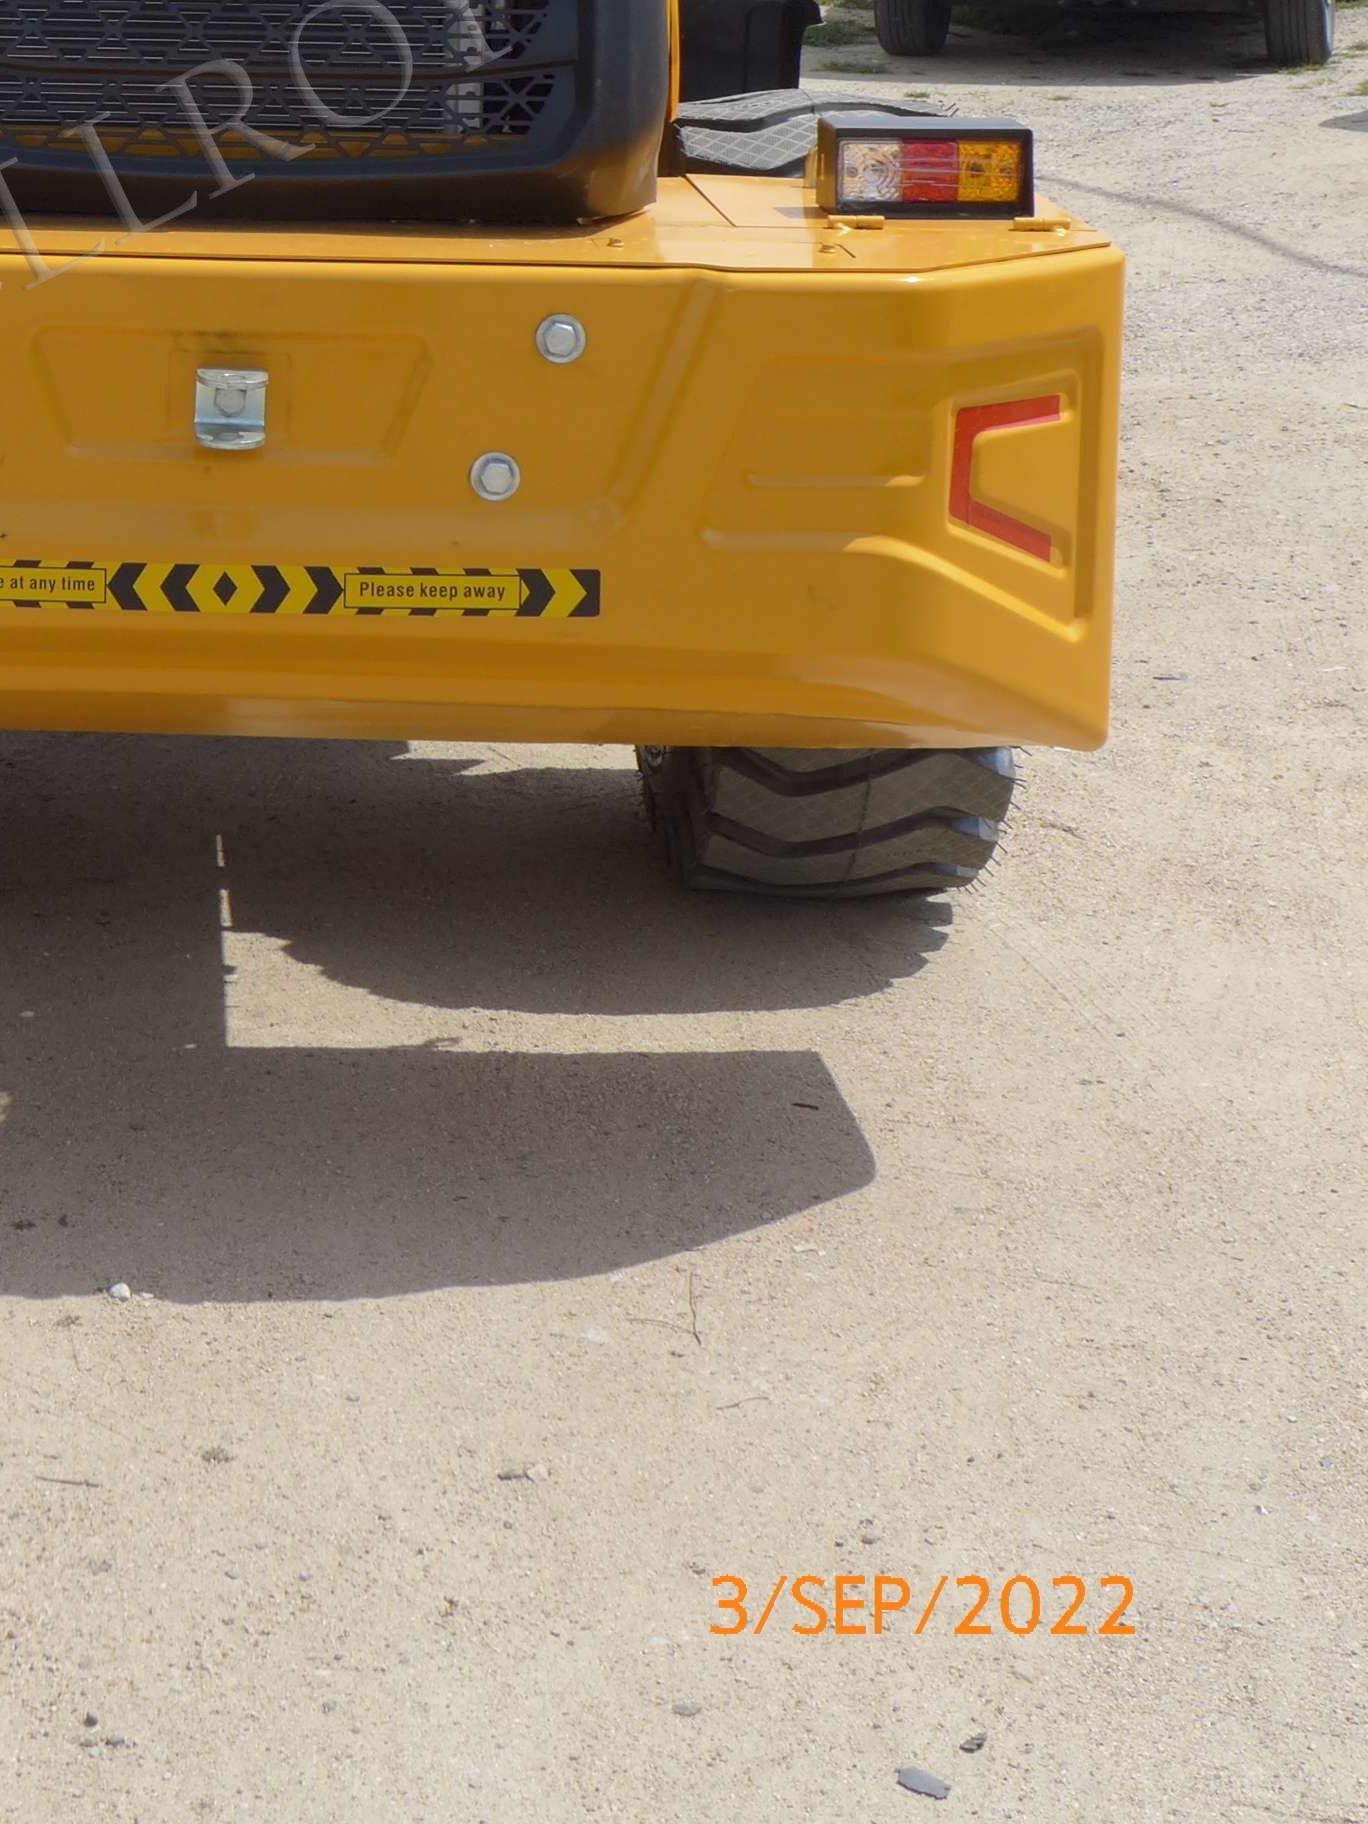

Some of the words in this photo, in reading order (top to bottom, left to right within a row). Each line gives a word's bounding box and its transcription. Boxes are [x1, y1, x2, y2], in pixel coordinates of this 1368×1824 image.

[9, 576, 25, 590] at
[30, 577, 56, 593] any
[61, 576, 96, 592] time
[359, 581, 415, 598] Please
[419, 582, 459, 601] keep
[463, 586, 506, 601] away
